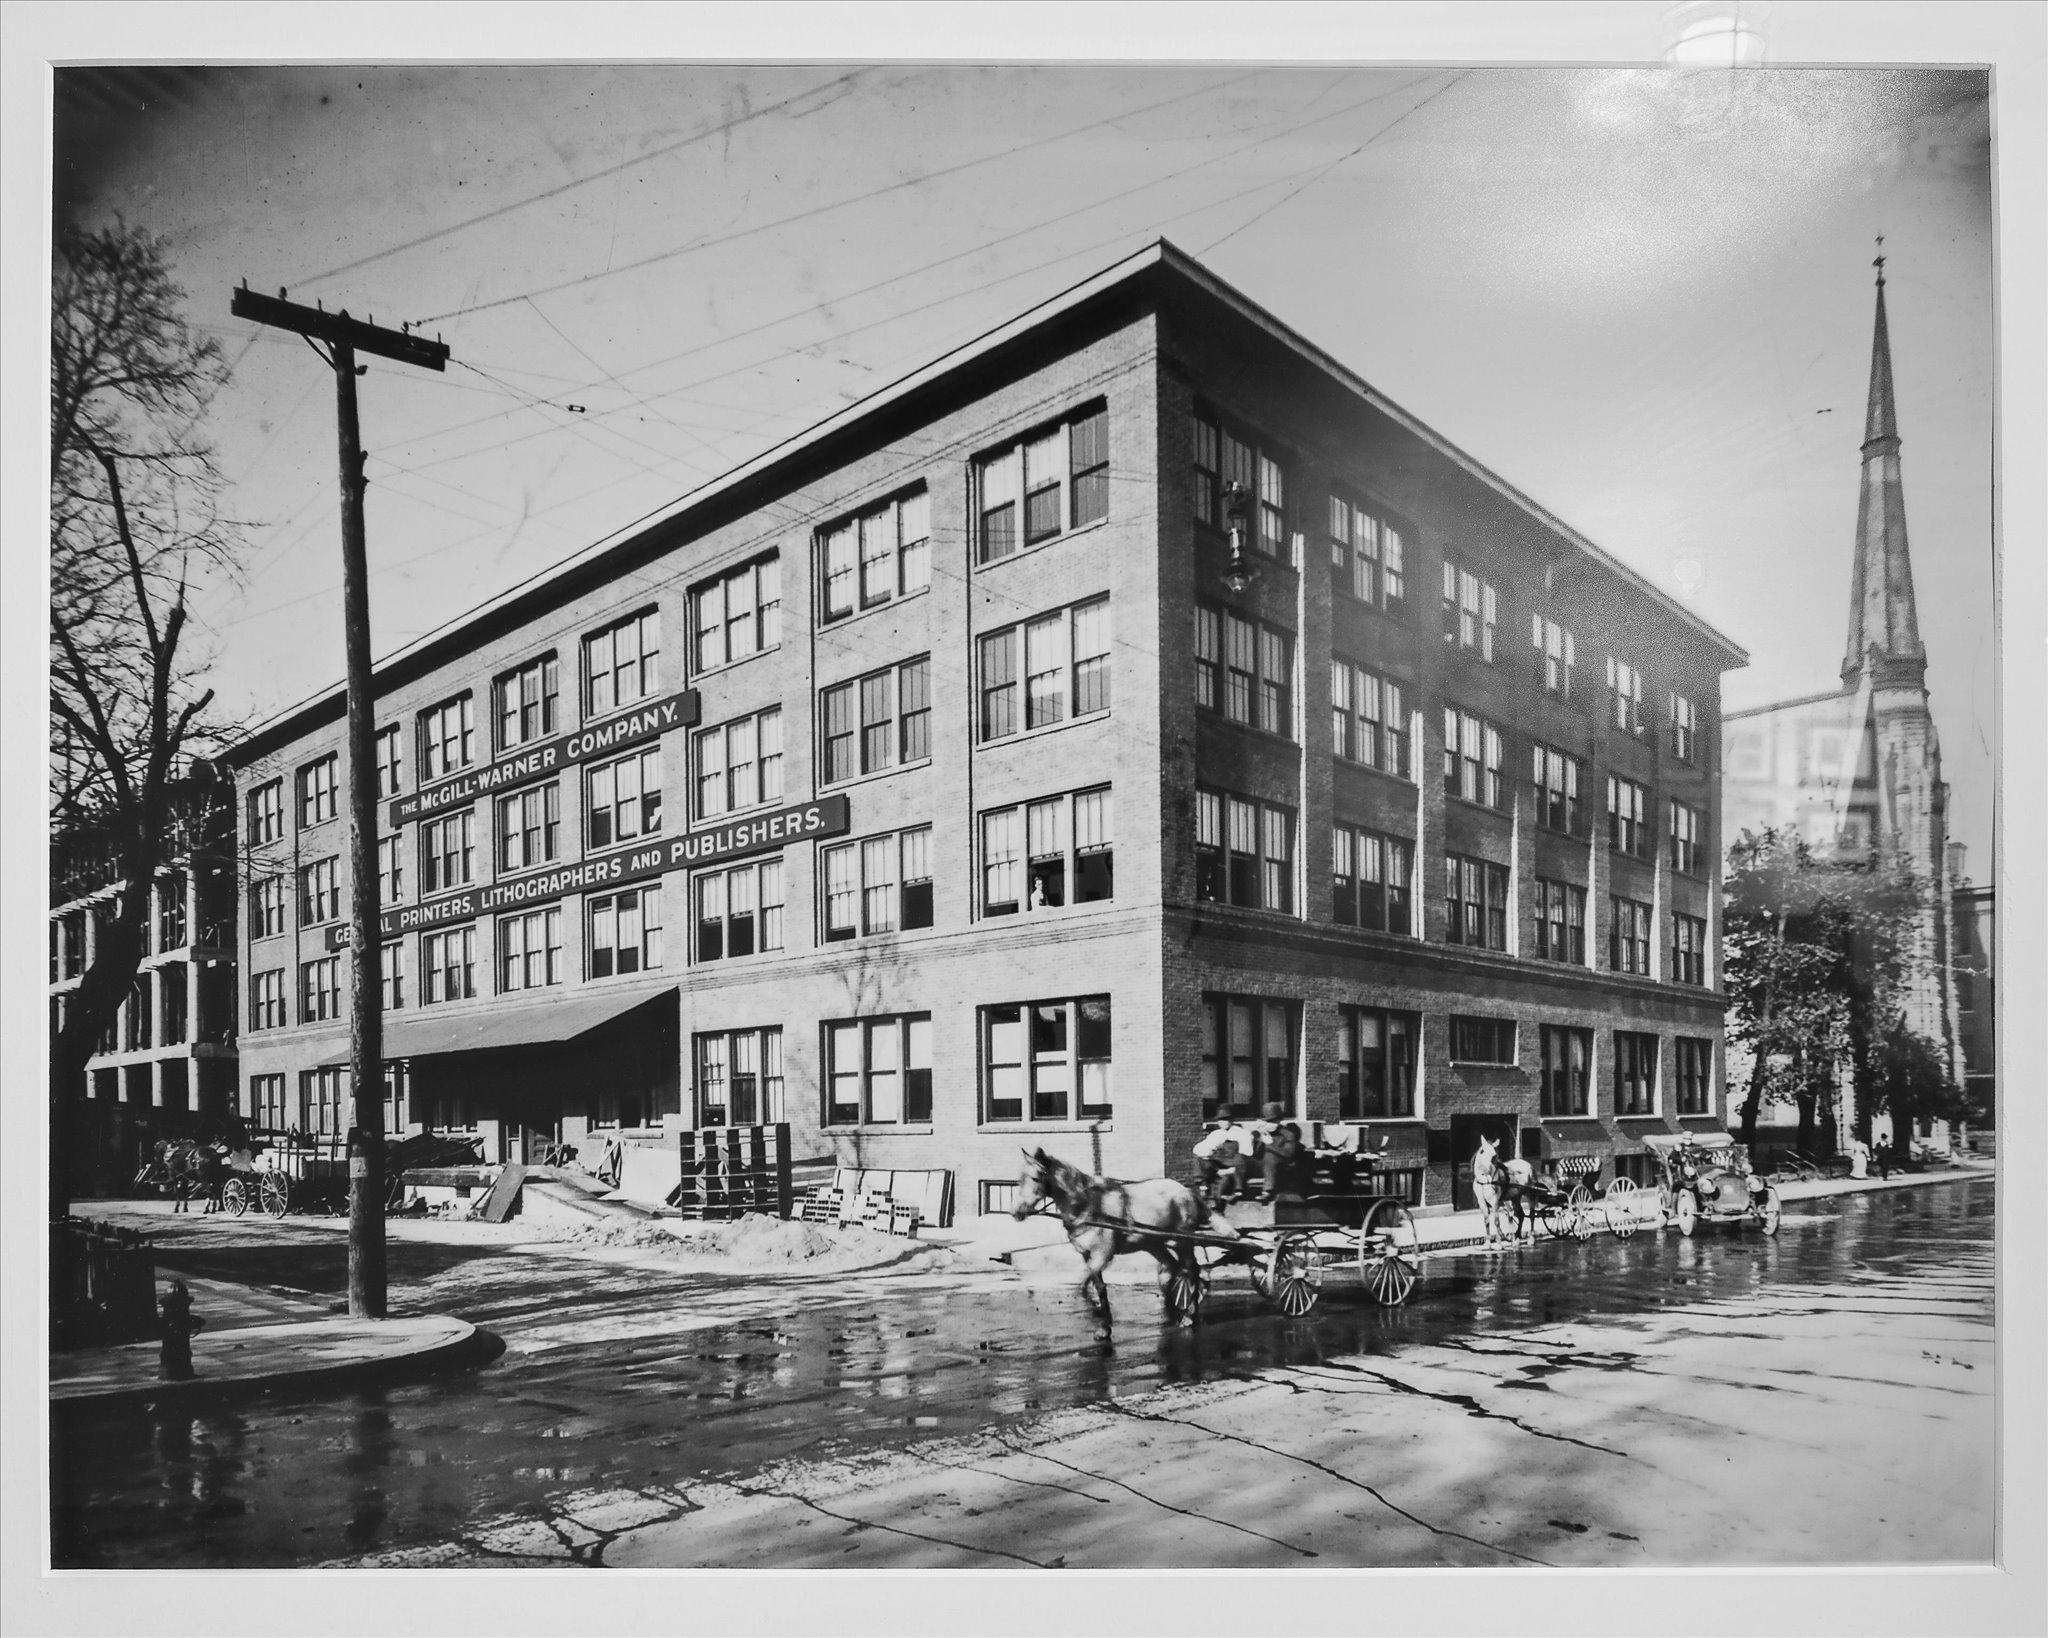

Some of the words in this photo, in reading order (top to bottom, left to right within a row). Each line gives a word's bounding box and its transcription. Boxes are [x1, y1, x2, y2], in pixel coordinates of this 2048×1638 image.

[400, 801, 418, 816] THE
[420, 748, 556, 811] McGILL-WARNER
[567, 701, 679, 759] COMPANY.
[481, 858, 622, 909] LITHOGRAPHERS
[631, 850, 662, 872] AND
[671, 807, 826, 864] PUBLISHERS.
